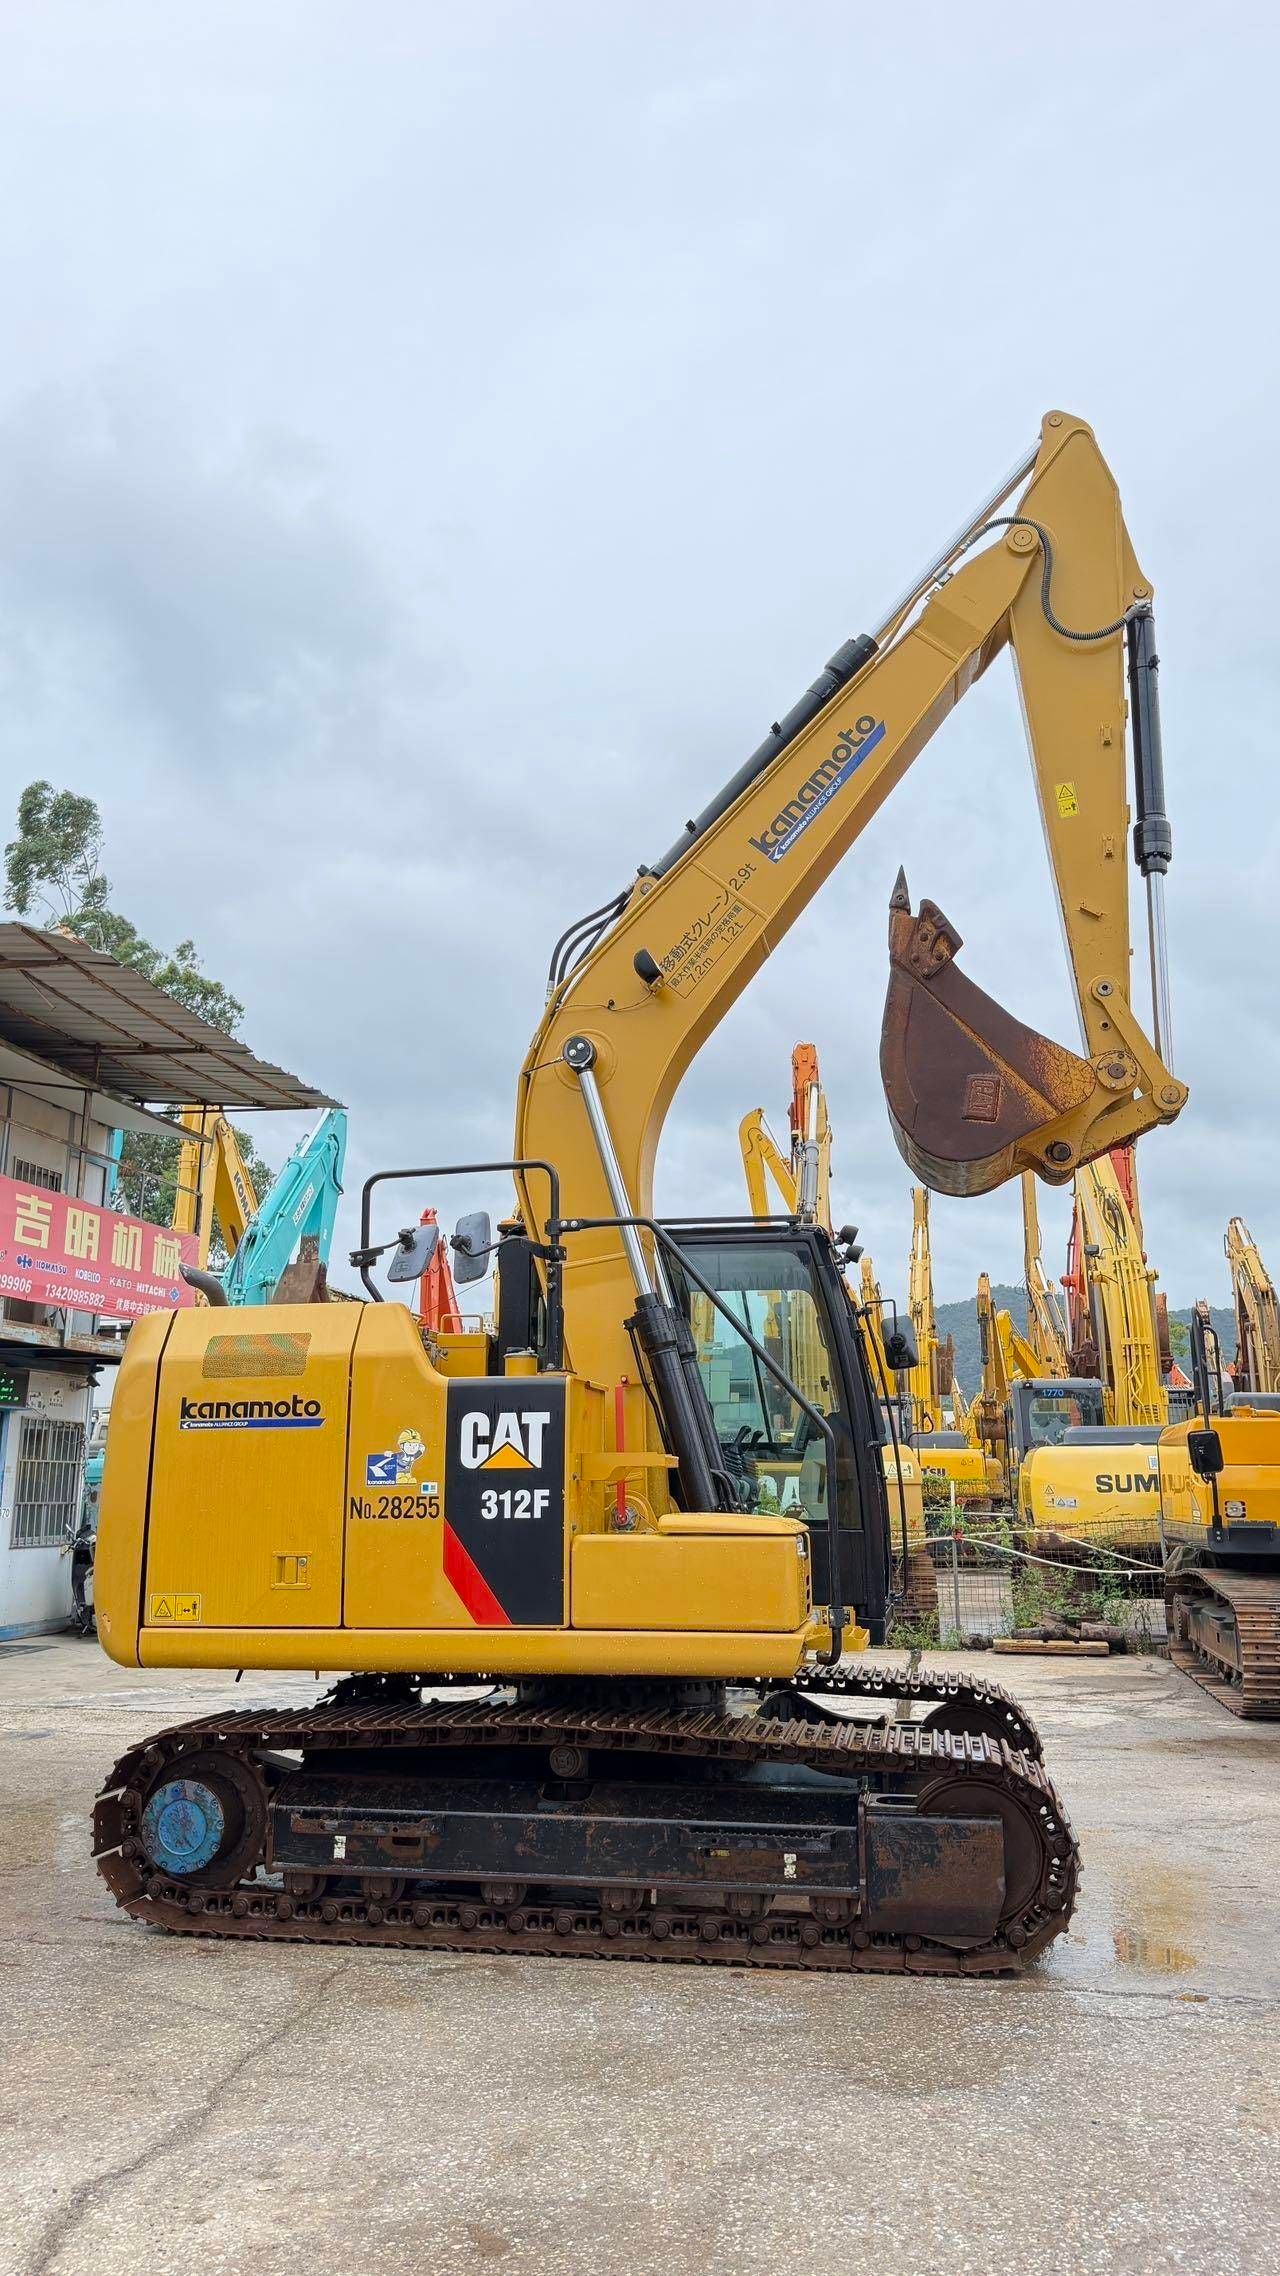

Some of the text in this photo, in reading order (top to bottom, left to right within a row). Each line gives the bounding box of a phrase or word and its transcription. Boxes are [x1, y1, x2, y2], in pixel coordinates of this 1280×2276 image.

[748, 715, 876, 856] kanamoto
[780, 776, 842, 850] kanamoto ALLIANCE GROUP
[659, 863, 757, 973] 移動式クレーン 2.9t
[686, 921, 744, 983] 7.2m 1.2t
[13, 1192, 182, 1282] 吉明机械
[0, 1273, 33, 1293] 99906
[35, 1259, 68, 1275] KOMATSU
[109, 1276, 132, 1289] KATO
[136, 1282, 166, 1298] HITACHI
[180, 1394, 321, 1419] kanamoto
[460, 1411, 550, 1469] CAT
[350, 1496, 440, 1519] No.28255
[481, 1489, 550, 1520] 312F
